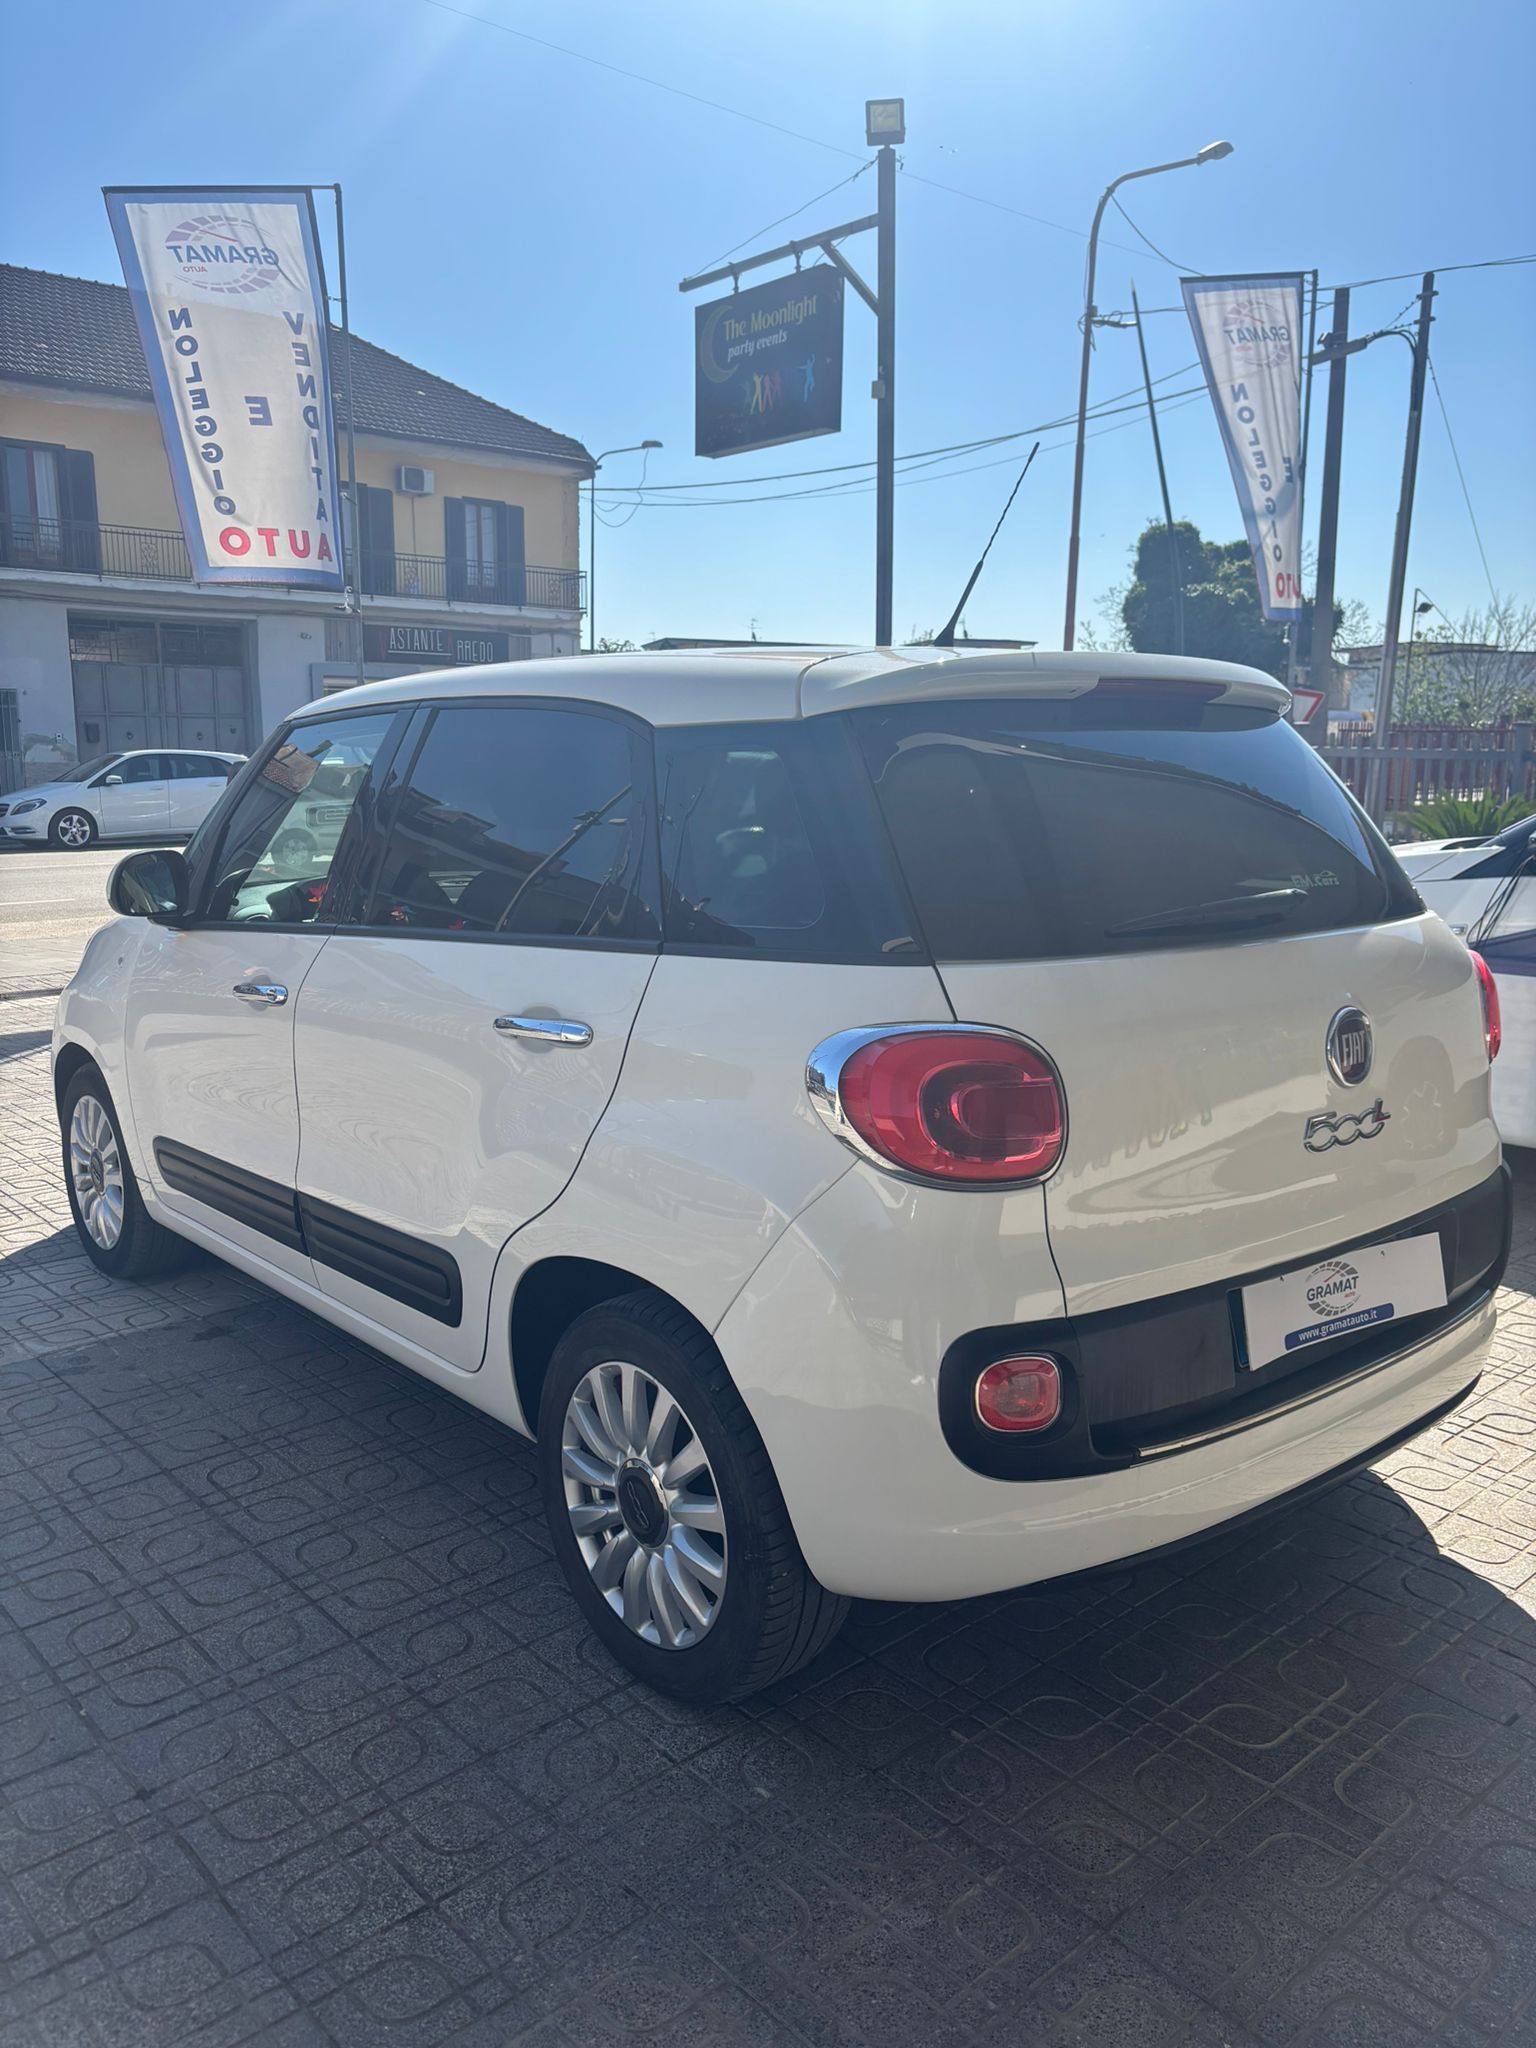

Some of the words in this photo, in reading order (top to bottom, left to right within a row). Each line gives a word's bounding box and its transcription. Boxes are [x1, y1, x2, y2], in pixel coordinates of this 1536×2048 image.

[724, 319, 747, 341] The
[750, 294, 818, 333] Moonlight
[727, 339, 755, 362] party
[756, 329, 788, 350] events
[1341, 1030, 1366, 1068] FIAT
[1306, 1275, 1359, 1302] GRAMAT
[1298, 1309, 1379, 1342] www.gramatauto.it
